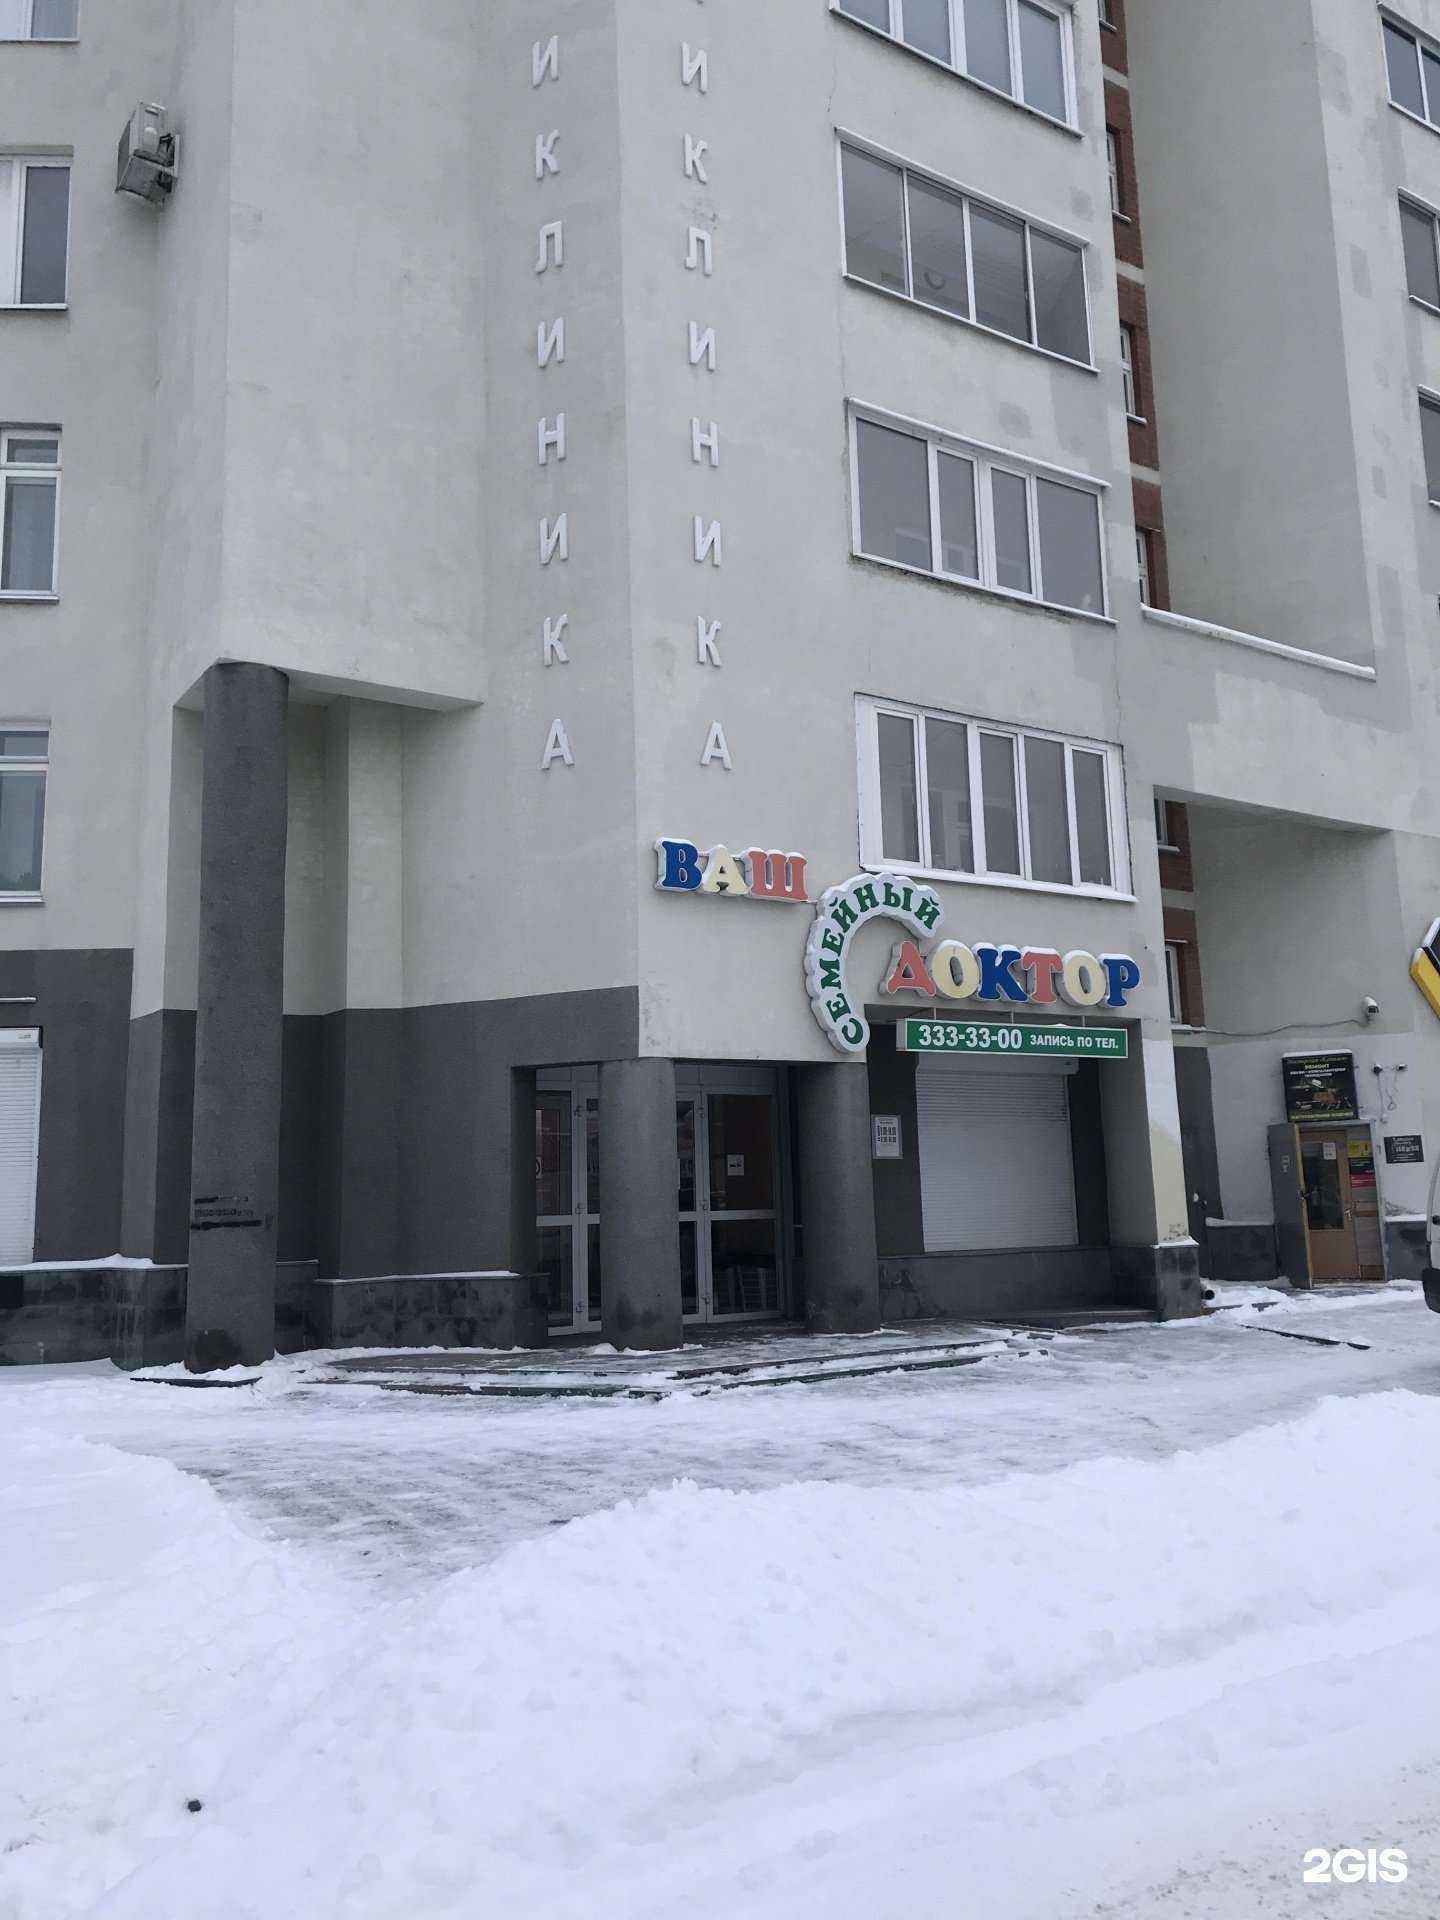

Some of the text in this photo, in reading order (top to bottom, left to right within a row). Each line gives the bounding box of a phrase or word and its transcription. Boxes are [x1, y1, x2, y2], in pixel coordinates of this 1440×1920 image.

[655, 837, 809, 902] ВАШ
[820, 882, 940, 1045] СЕМЕЙНЫЙ
[881, 939, 1141, 1008] ДОКТОР
[918, 1024, 1118, 1049] 333-33-00 ЗАПИСЬ ПО ТЕЛ.
